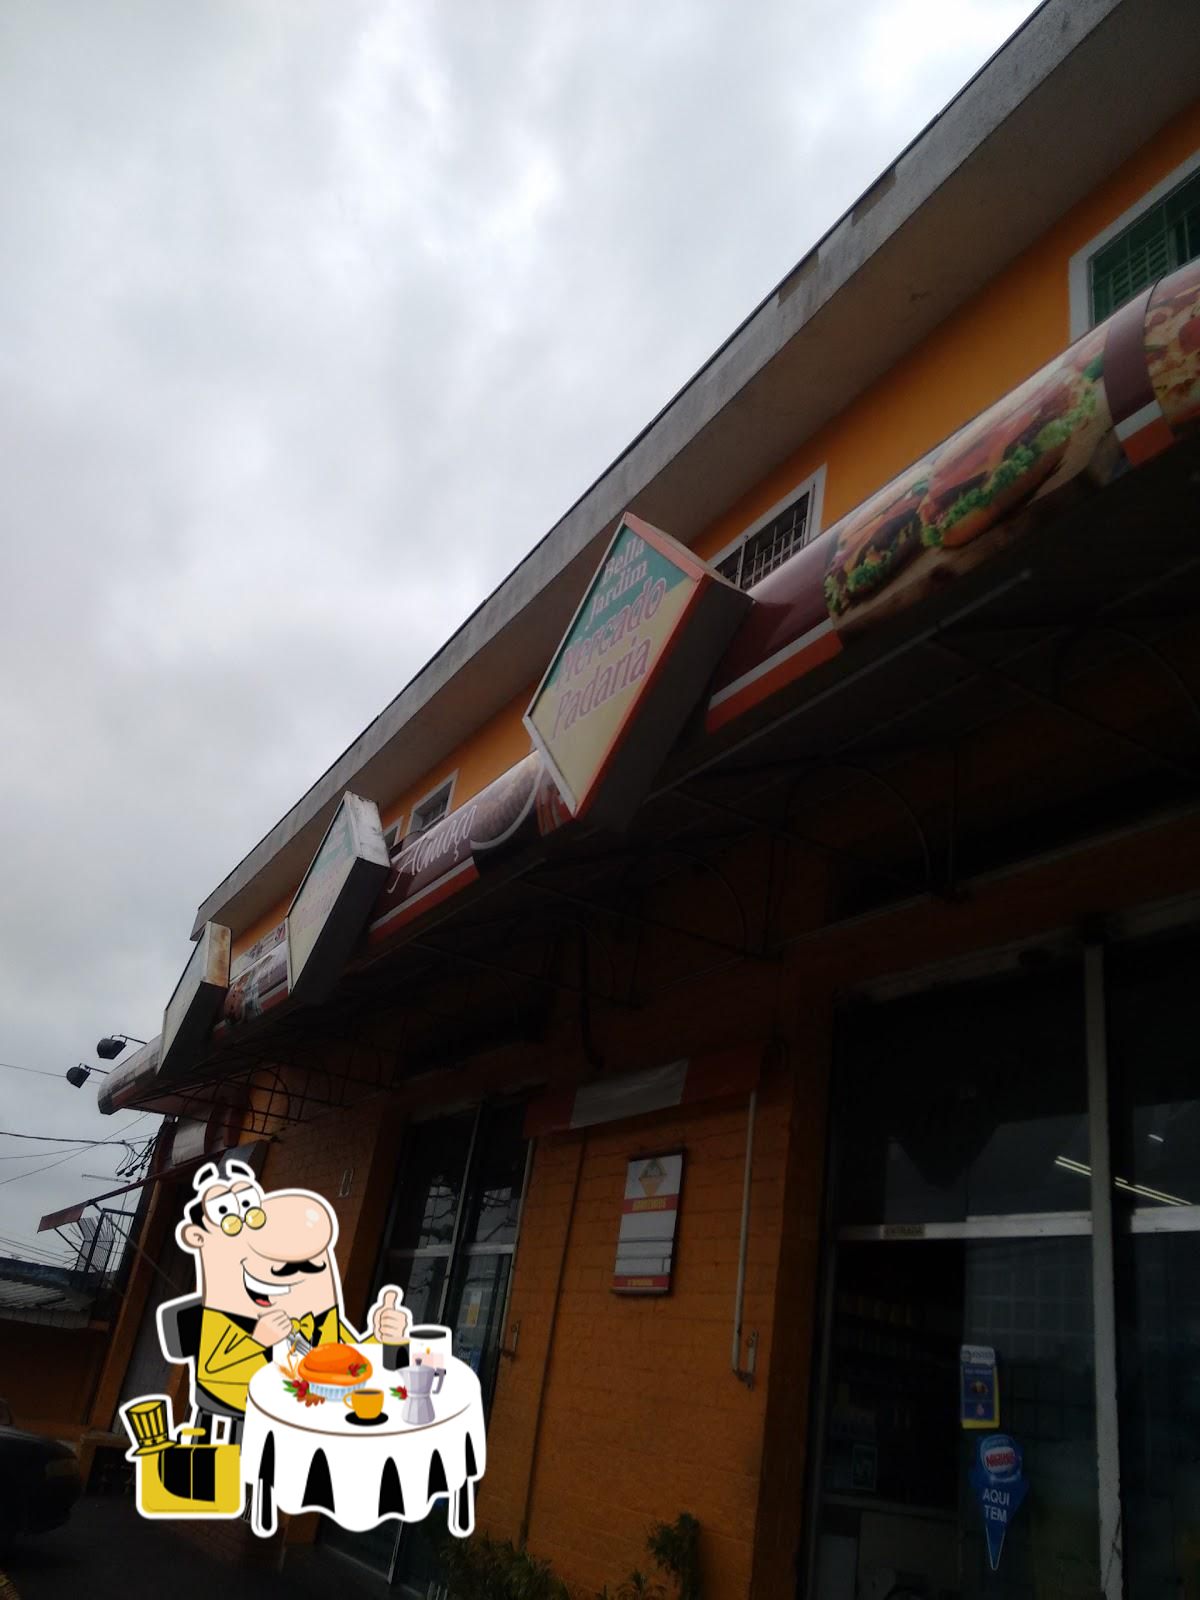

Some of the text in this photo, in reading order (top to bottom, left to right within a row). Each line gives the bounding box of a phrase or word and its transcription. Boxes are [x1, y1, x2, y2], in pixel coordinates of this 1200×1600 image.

[586, 559, 649, 631] Jardim
[555, 576, 667, 692] Mercado
[551, 636, 652, 740] Padaria
[982, 1488, 1010, 1506] AQUI
[984, 1505, 1007, 1522] TEM
